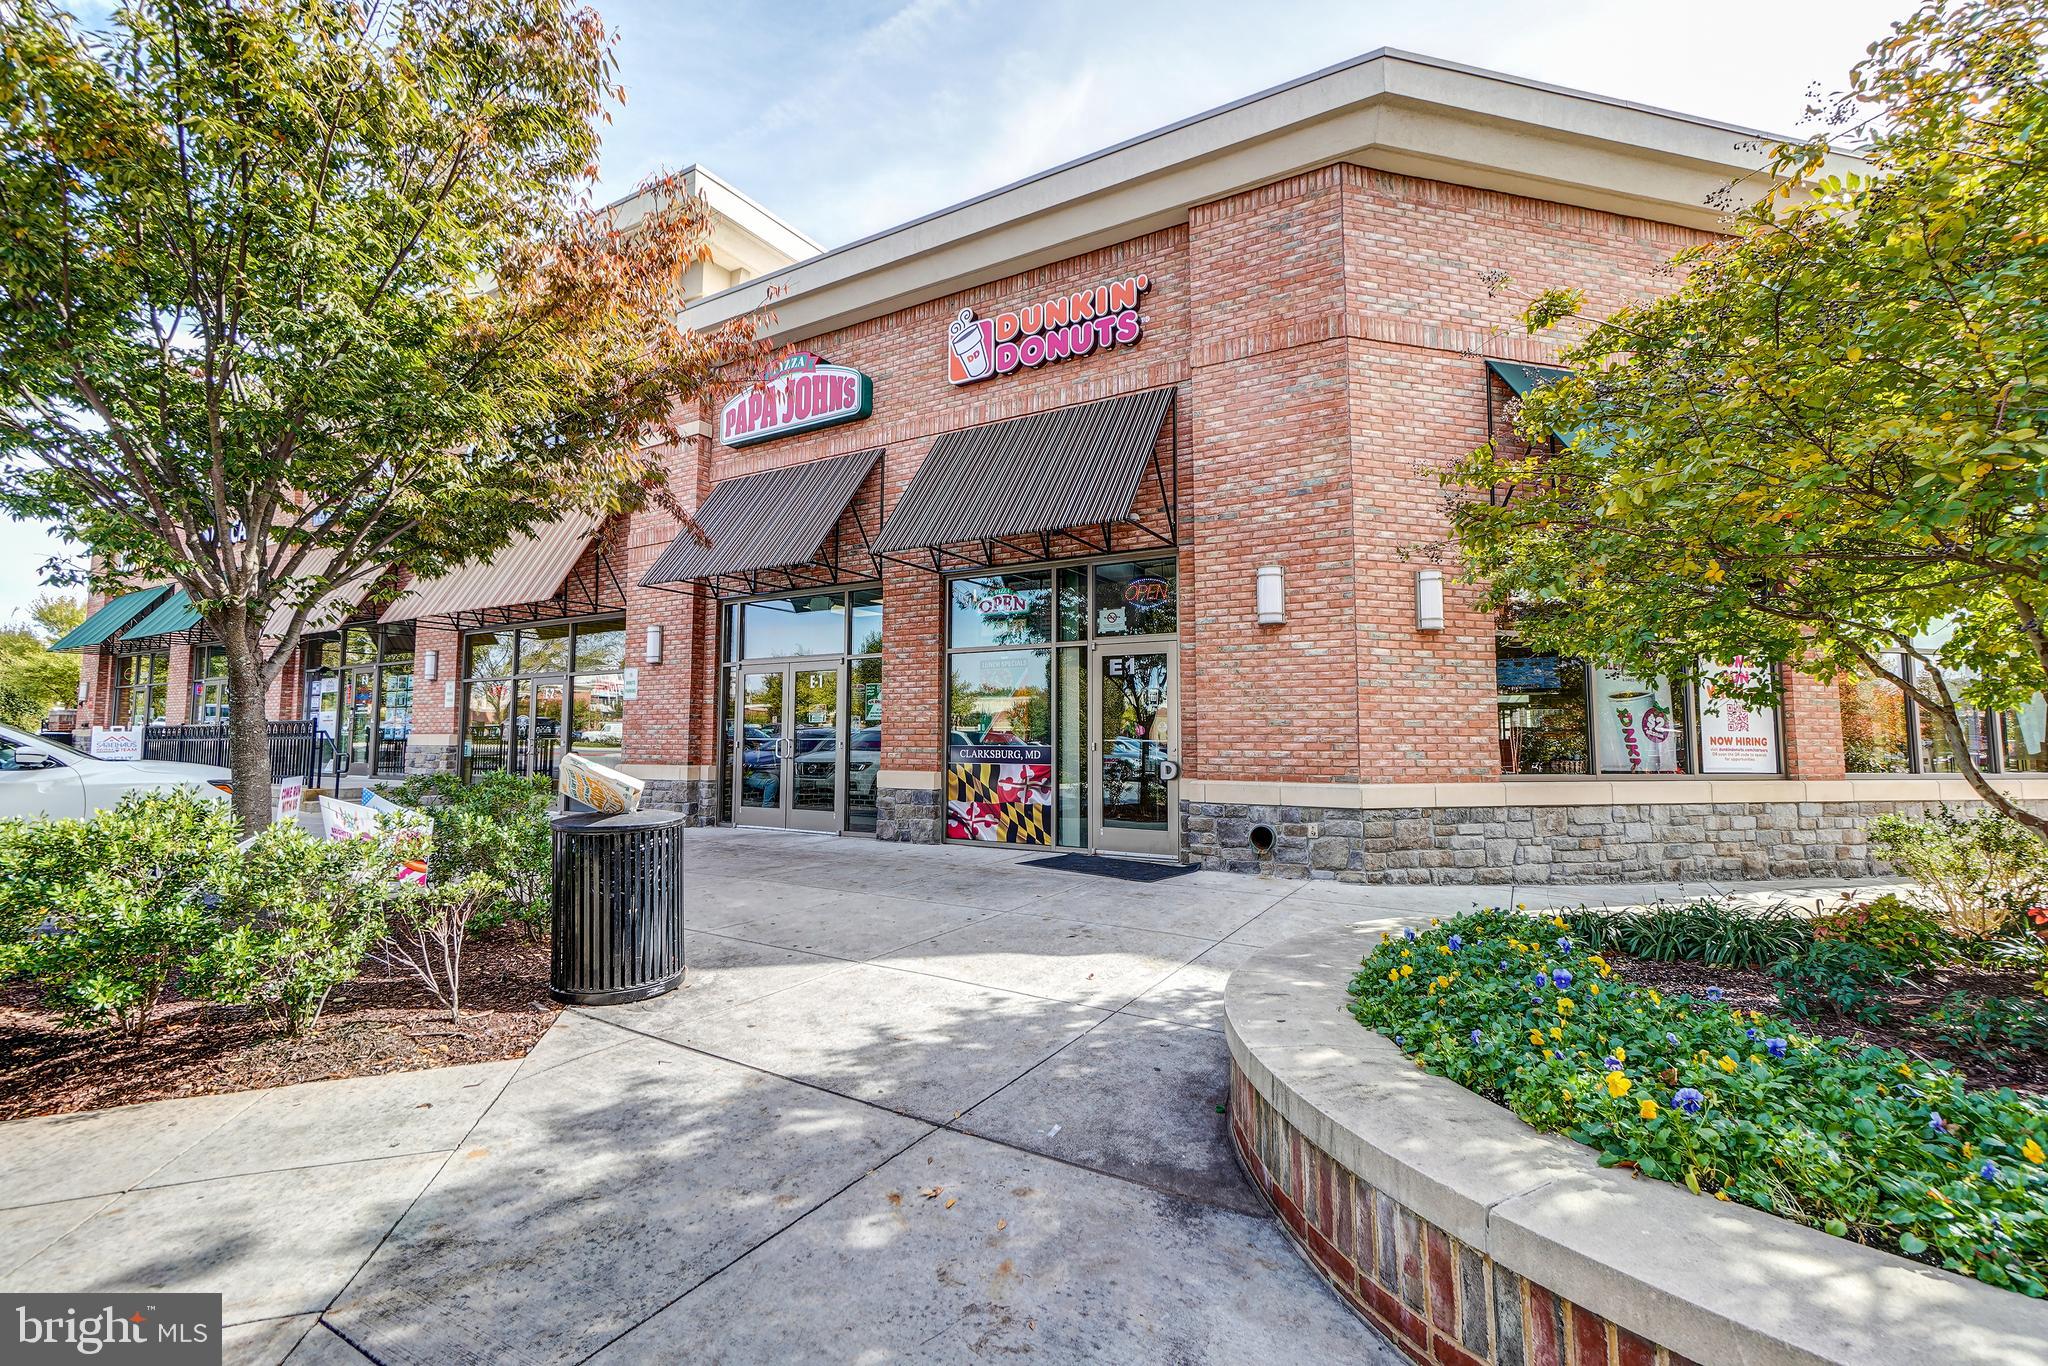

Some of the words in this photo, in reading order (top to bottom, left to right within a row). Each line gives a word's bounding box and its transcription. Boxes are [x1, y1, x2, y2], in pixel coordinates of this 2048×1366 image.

[996, 274, 1148, 342] DUNKIN'
[996, 310, 1140, 374] DONUTS
[967, 350, 980, 364] DD
[782, 374, 856, 424] JOHN'S
[725, 385, 778, 438] PAPA
[1125, 584, 1168, 601] OPEN
[979, 595, 1026, 613] OPEN
[1646, 713, 1665, 732] $2
[1710, 736, 1733, 746] NOW
[1736, 737, 1768, 747] HIRING
[960, 749, 1024, 761] CLARKSBURG,
[1025, 750, 1041, 760] MD
